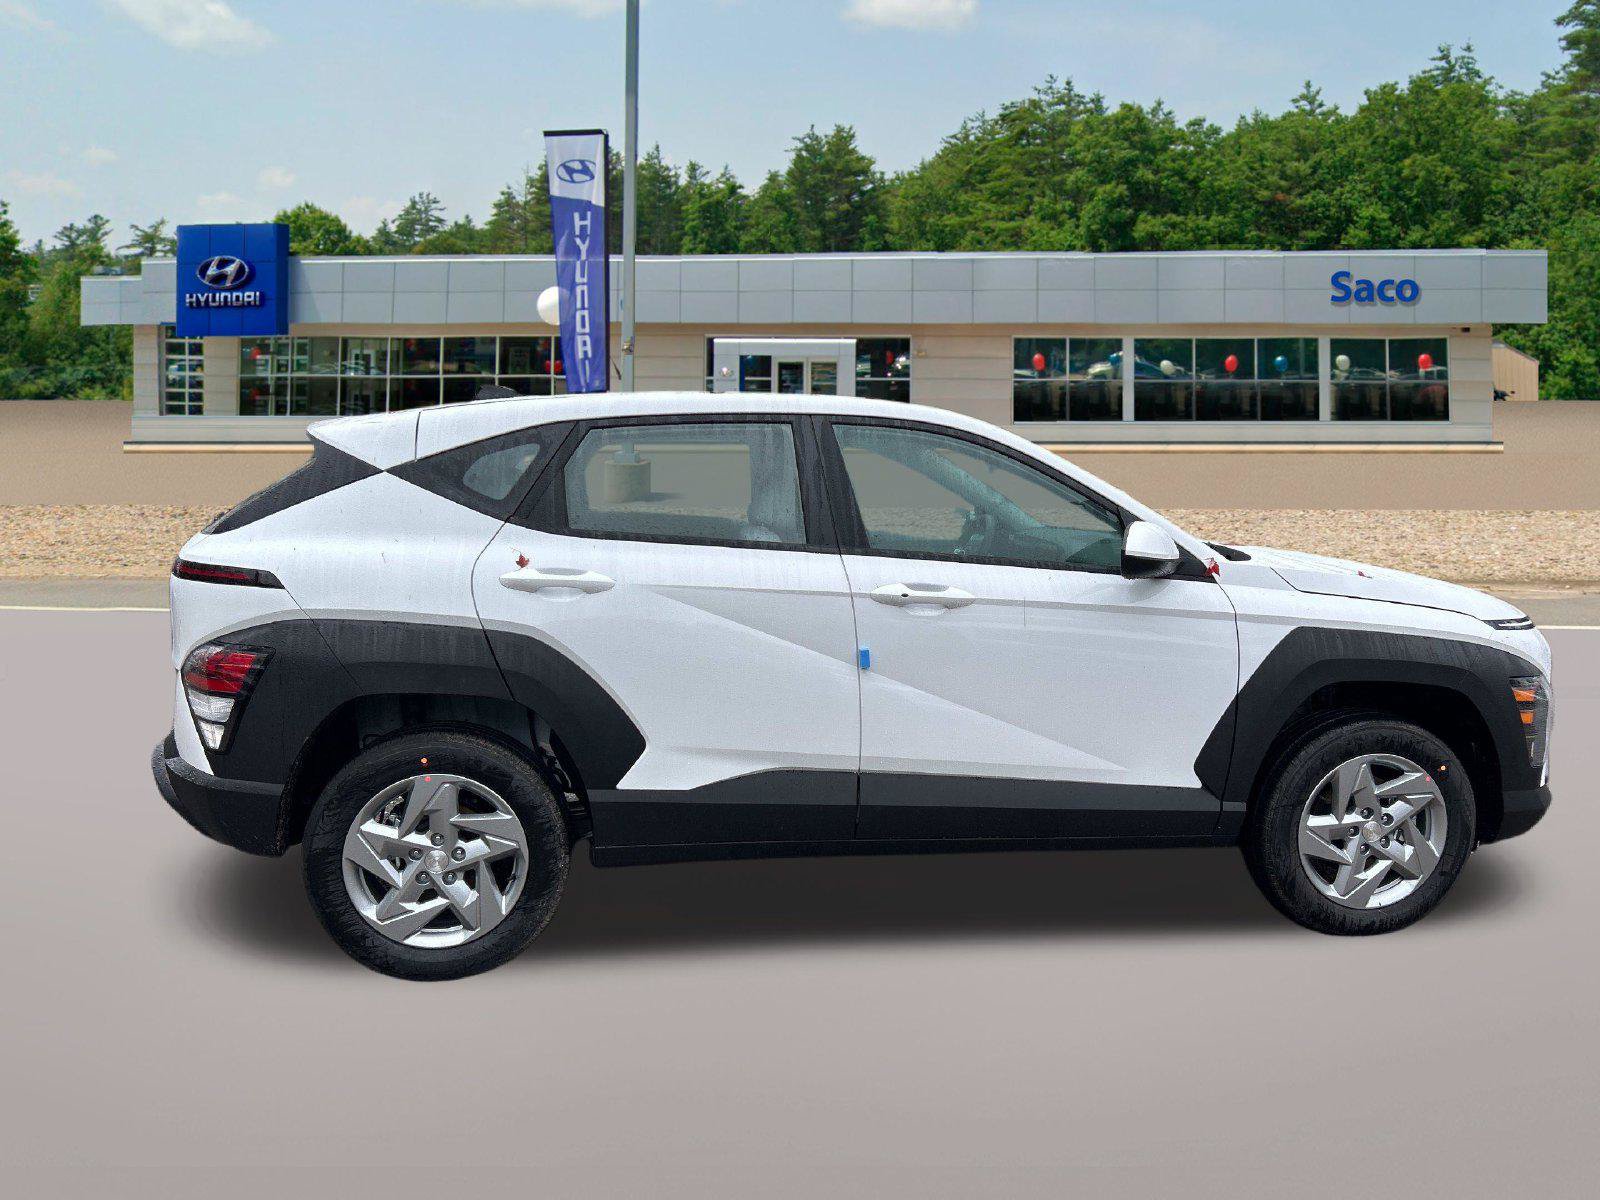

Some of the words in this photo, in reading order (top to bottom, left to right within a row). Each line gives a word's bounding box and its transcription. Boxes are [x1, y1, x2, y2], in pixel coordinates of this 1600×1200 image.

[185, 291, 260, 307] HYUNDAI
[573, 211, 592, 383] HYUNDAI
[1330, 270, 1420, 303] Saco
